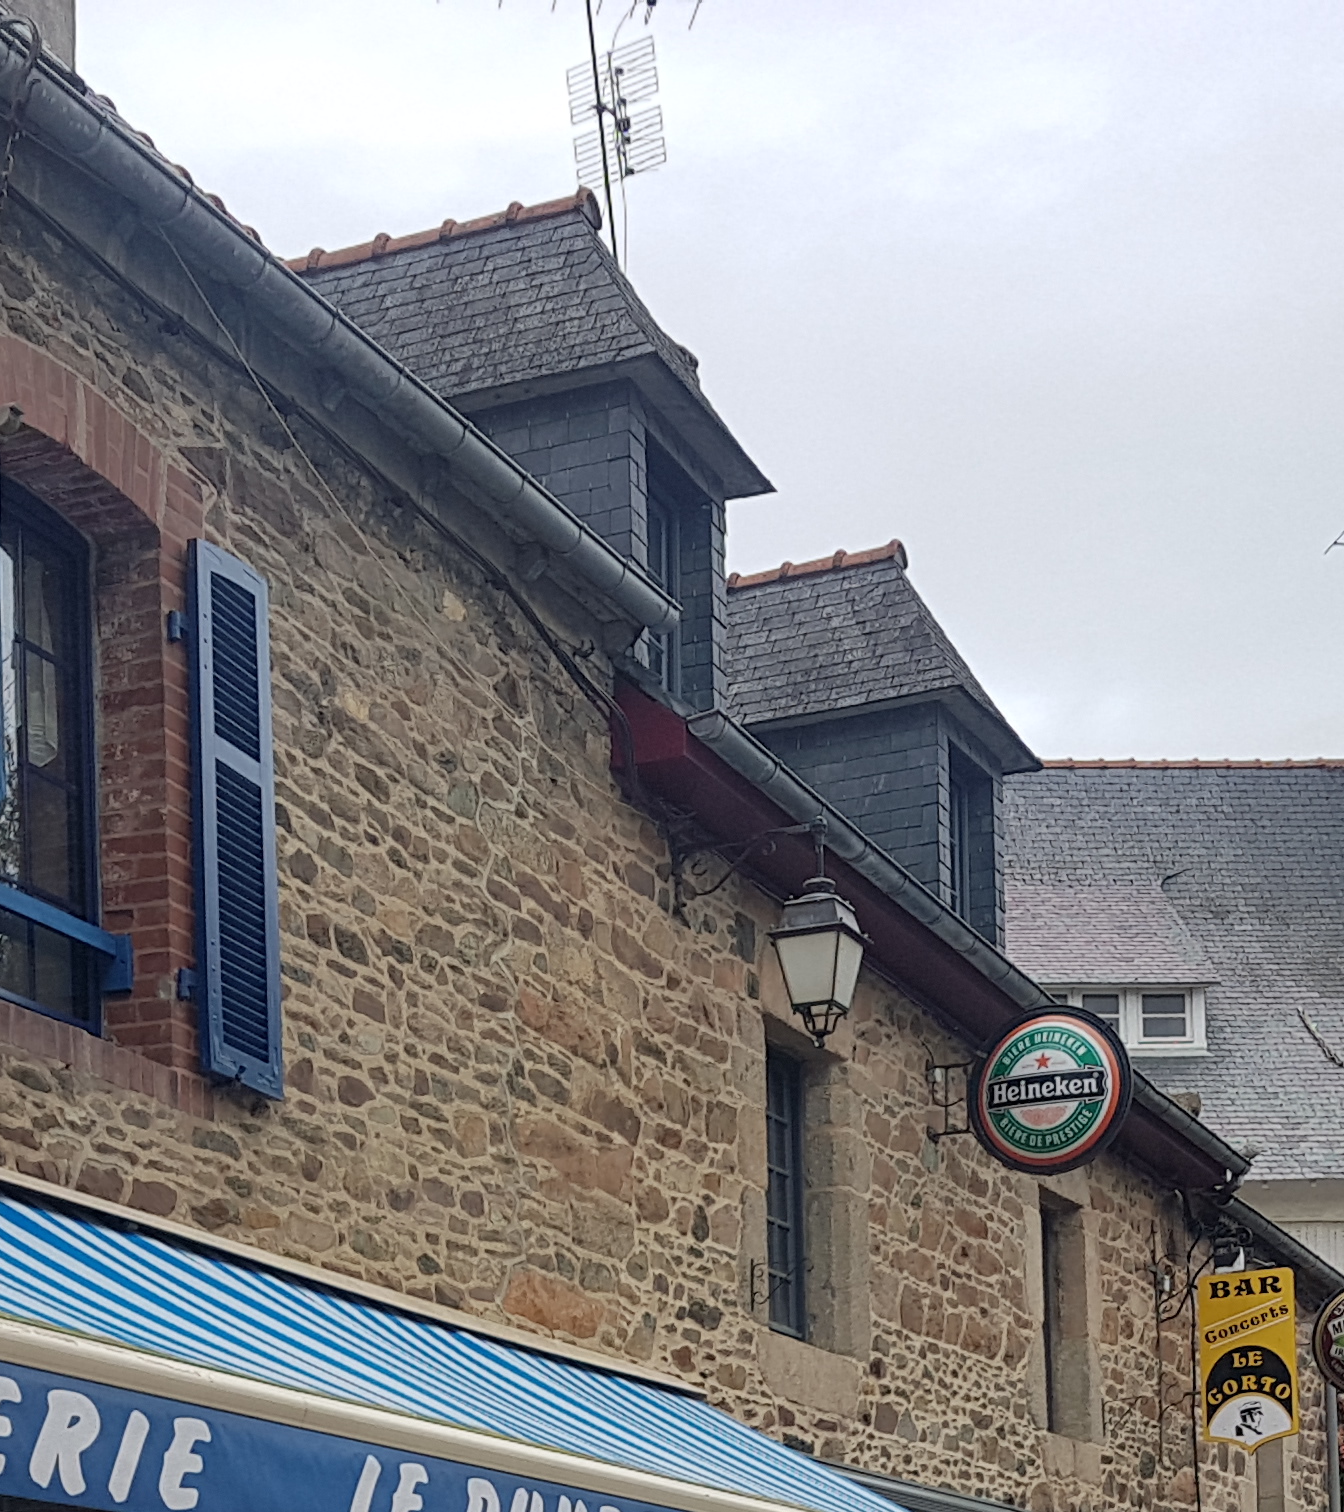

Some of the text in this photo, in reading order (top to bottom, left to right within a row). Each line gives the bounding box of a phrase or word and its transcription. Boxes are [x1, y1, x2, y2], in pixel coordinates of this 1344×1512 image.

[1034, 1032, 1088, 1056] HEINEKEN
[993, 1075, 1098, 1104] Heineken
[1029, 1135, 1043, 1147] DE
[1045, 1109, 1093, 1147] PRESTIGE
[1209, 1276, 1282, 1299] BAR
[1205, 1305, 1289, 1343] Concerts
[1232, 1351, 1263, 1368] LE
